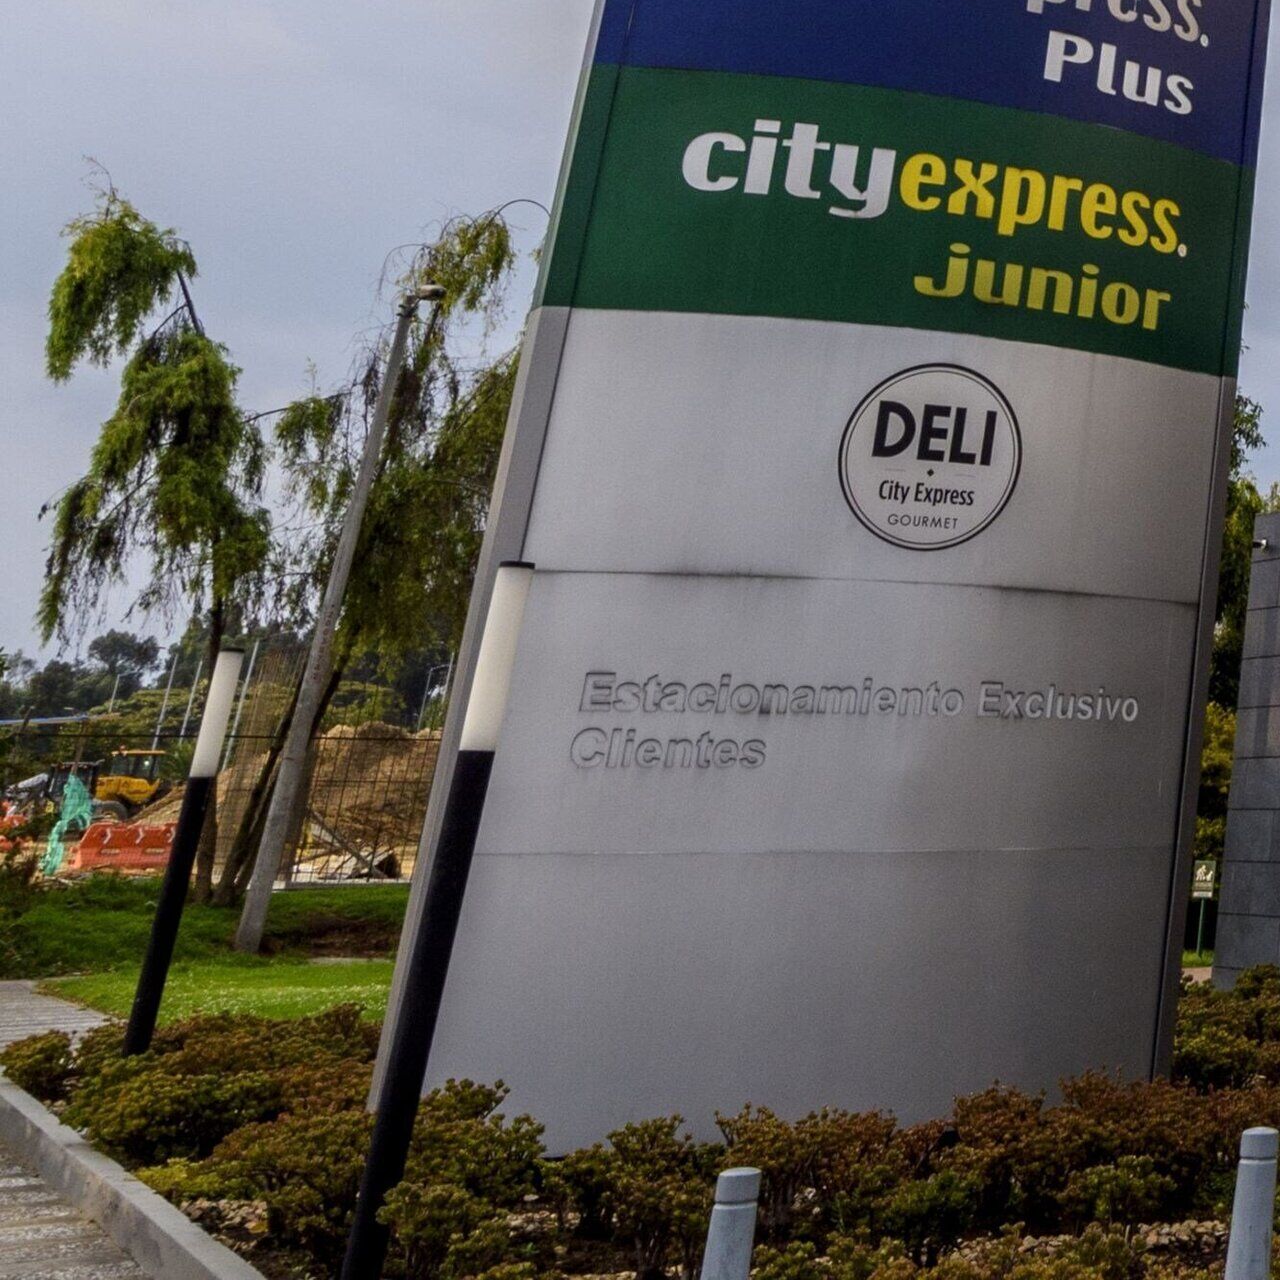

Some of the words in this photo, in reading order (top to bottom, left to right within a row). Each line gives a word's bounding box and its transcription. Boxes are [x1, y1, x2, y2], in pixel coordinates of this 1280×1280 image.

[1043, 30, 1194, 115] Plus
[913, 242, 1171, 330] junior
[871, 400, 998, 467] DELI
[878, 479, 911, 505] City
[913, 482, 976, 507] Express
[887, 513, 959, 530] GOURMET
[579, 671, 965, 718] Estacionamiento
[977, 681, 1140, 721] Exclusivo
[570, 726, 767, 769] Clientes
